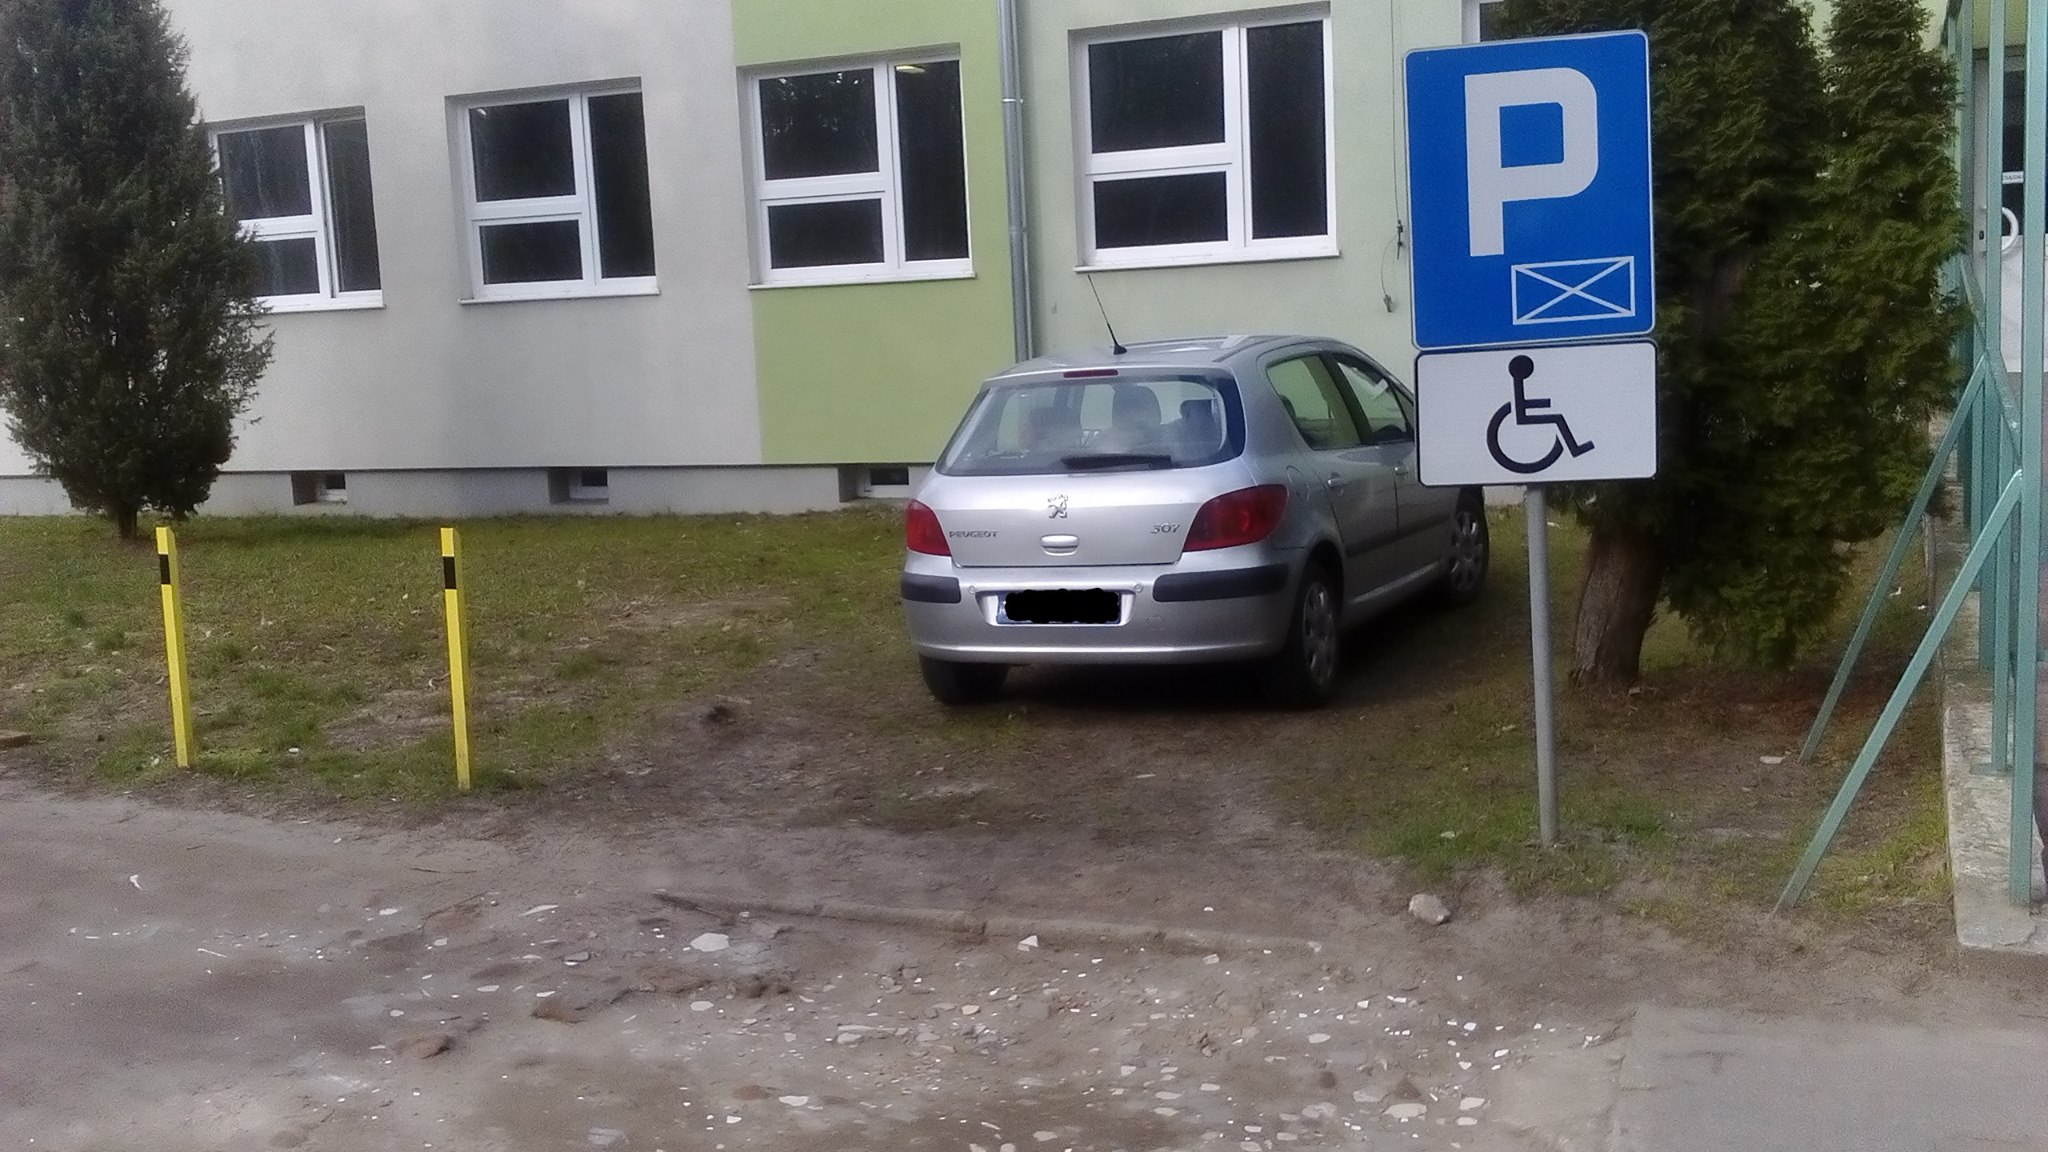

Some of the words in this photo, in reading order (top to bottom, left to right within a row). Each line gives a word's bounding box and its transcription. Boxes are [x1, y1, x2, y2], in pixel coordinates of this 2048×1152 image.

[1465, 67, 1598, 256] P
[948, 529, 998, 539] PEUGEOT
[1150, 523, 1181, 534] 307
